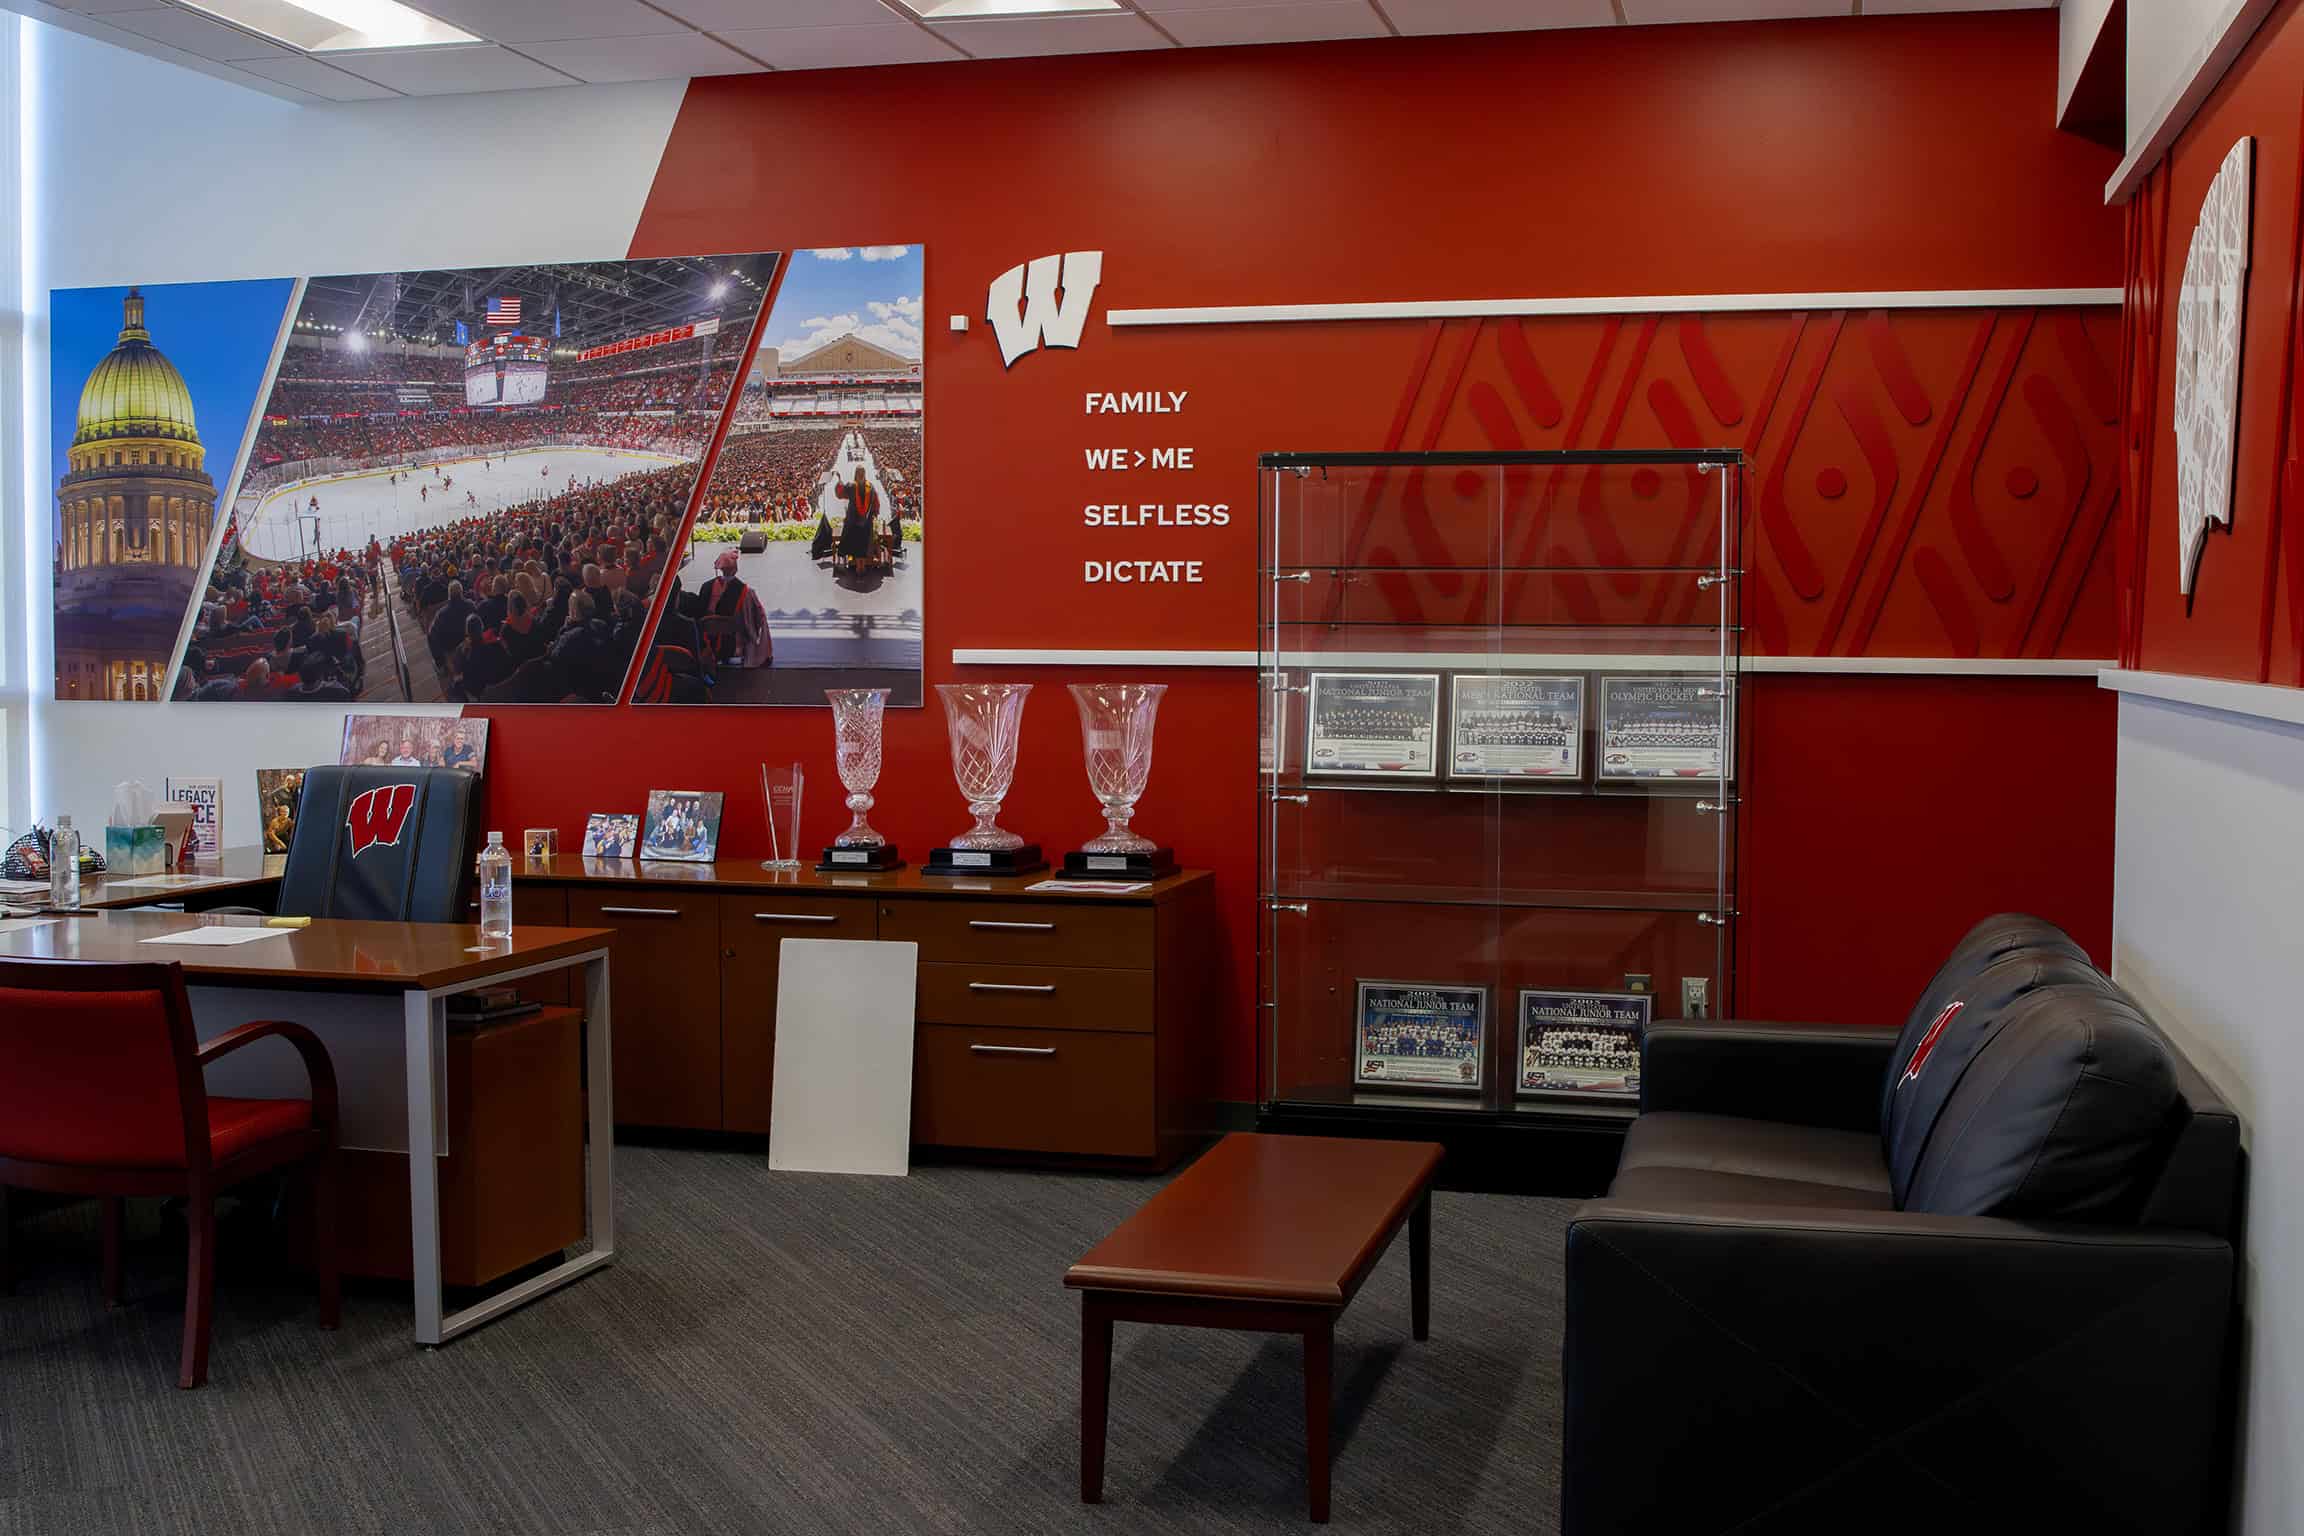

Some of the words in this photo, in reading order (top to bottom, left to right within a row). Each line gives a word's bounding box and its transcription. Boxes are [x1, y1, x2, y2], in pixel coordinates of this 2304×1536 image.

[986, 251, 1103, 369] W
[1085, 391, 1188, 414] FAMILY
[1084, 504, 1231, 526] SELFLESS
[1084, 560, 1203, 583] DICTATE
[1547, 691, 1575, 700] TEAM
[1610, 692, 1653, 702] OLYMPIC
[1655, 692, 1696, 702] HOCKEY
[172, 790, 216, 803] LEGACY
[346, 784, 416, 858] W
[1369, 998, 1415, 1009] NATIONAL
[1416, 1000, 1447, 1010] JUNIOR
[1449, 1002, 1475, 1011] TEAM
[1532, 1007, 1578, 1017] NATIONAL
[1579, 1008, 1612, 1018] JUNIOR
[1613, 1010, 1640, 1020] TEAM
